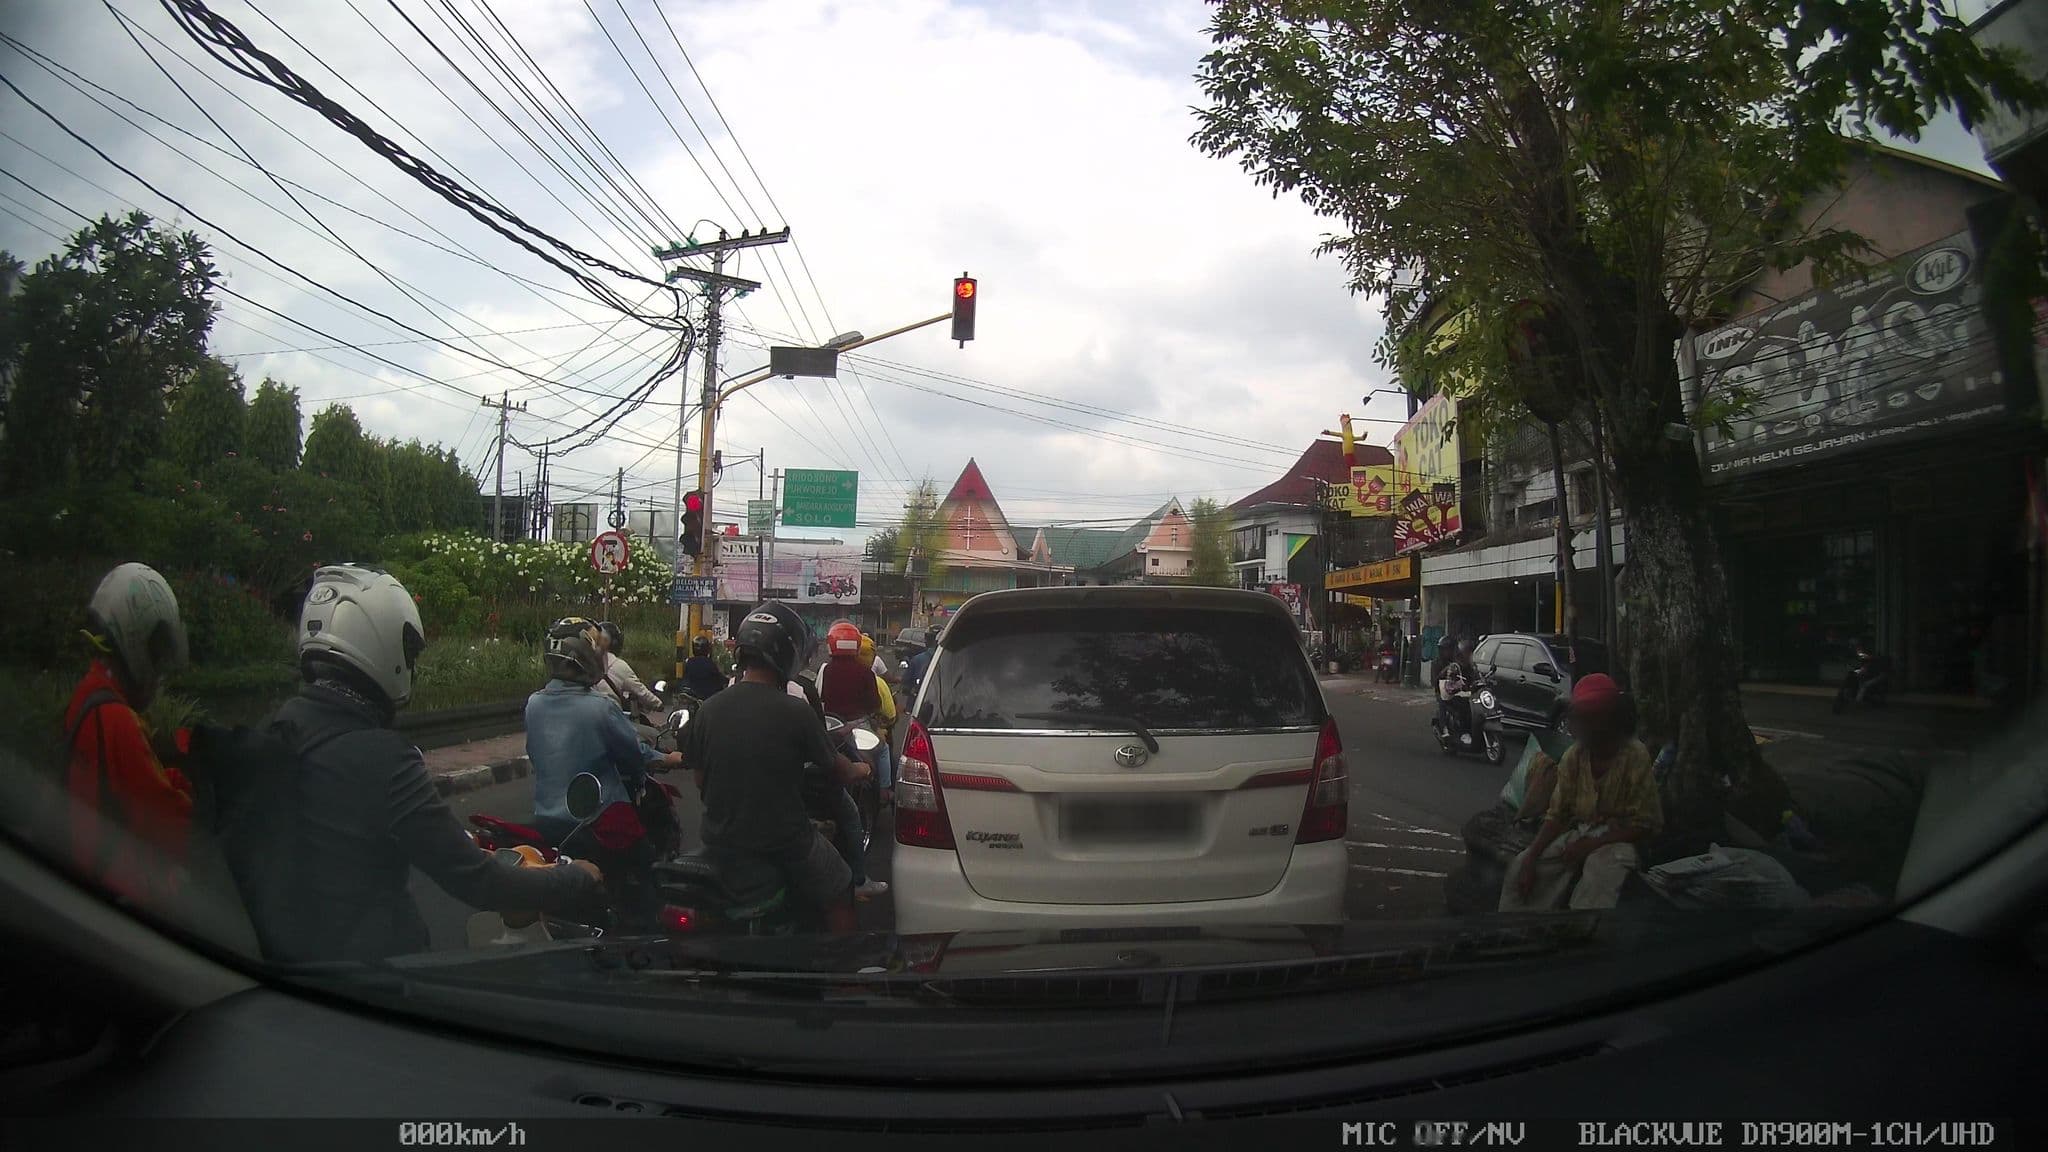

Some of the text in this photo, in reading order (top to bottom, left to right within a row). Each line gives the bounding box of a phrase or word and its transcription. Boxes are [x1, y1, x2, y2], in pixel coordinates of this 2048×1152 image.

[1707, 329, 1748, 355] INK
[1413, 400, 1448, 455] TOKO
[1752, 448, 1790, 464] HELM
[1792, 431, 1866, 456] GEJAYAN
[1419, 444, 1442, 485] CAT
[796, 513, 832, 523] SOLO
